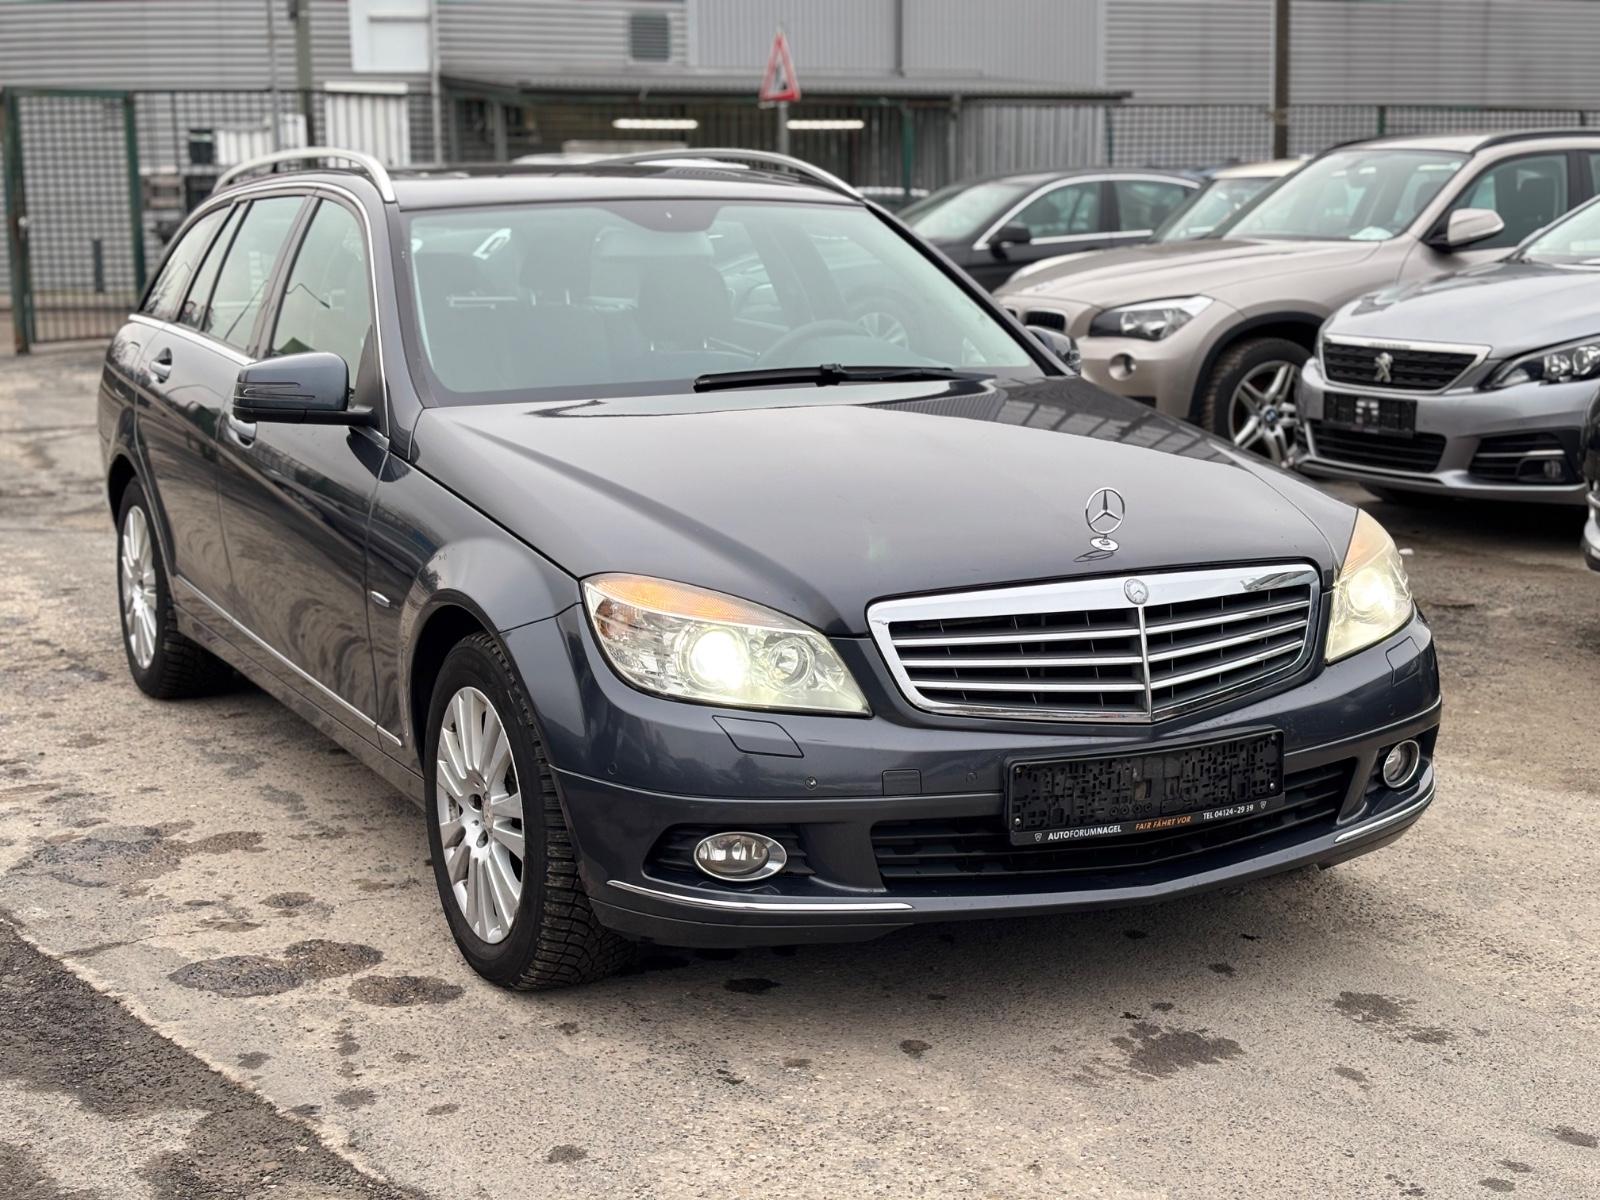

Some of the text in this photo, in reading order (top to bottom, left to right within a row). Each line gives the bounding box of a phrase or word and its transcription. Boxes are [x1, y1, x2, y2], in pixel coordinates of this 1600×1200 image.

[1047, 825, 1122, 841] AUTOFORUMNAGEL
[1135, 822, 1152, 831] FAIR
[1153, 817, 1176, 829] FÄHRT
[1177, 815, 1191, 825] VOR
[1203, 812, 1214, 821] TEL
